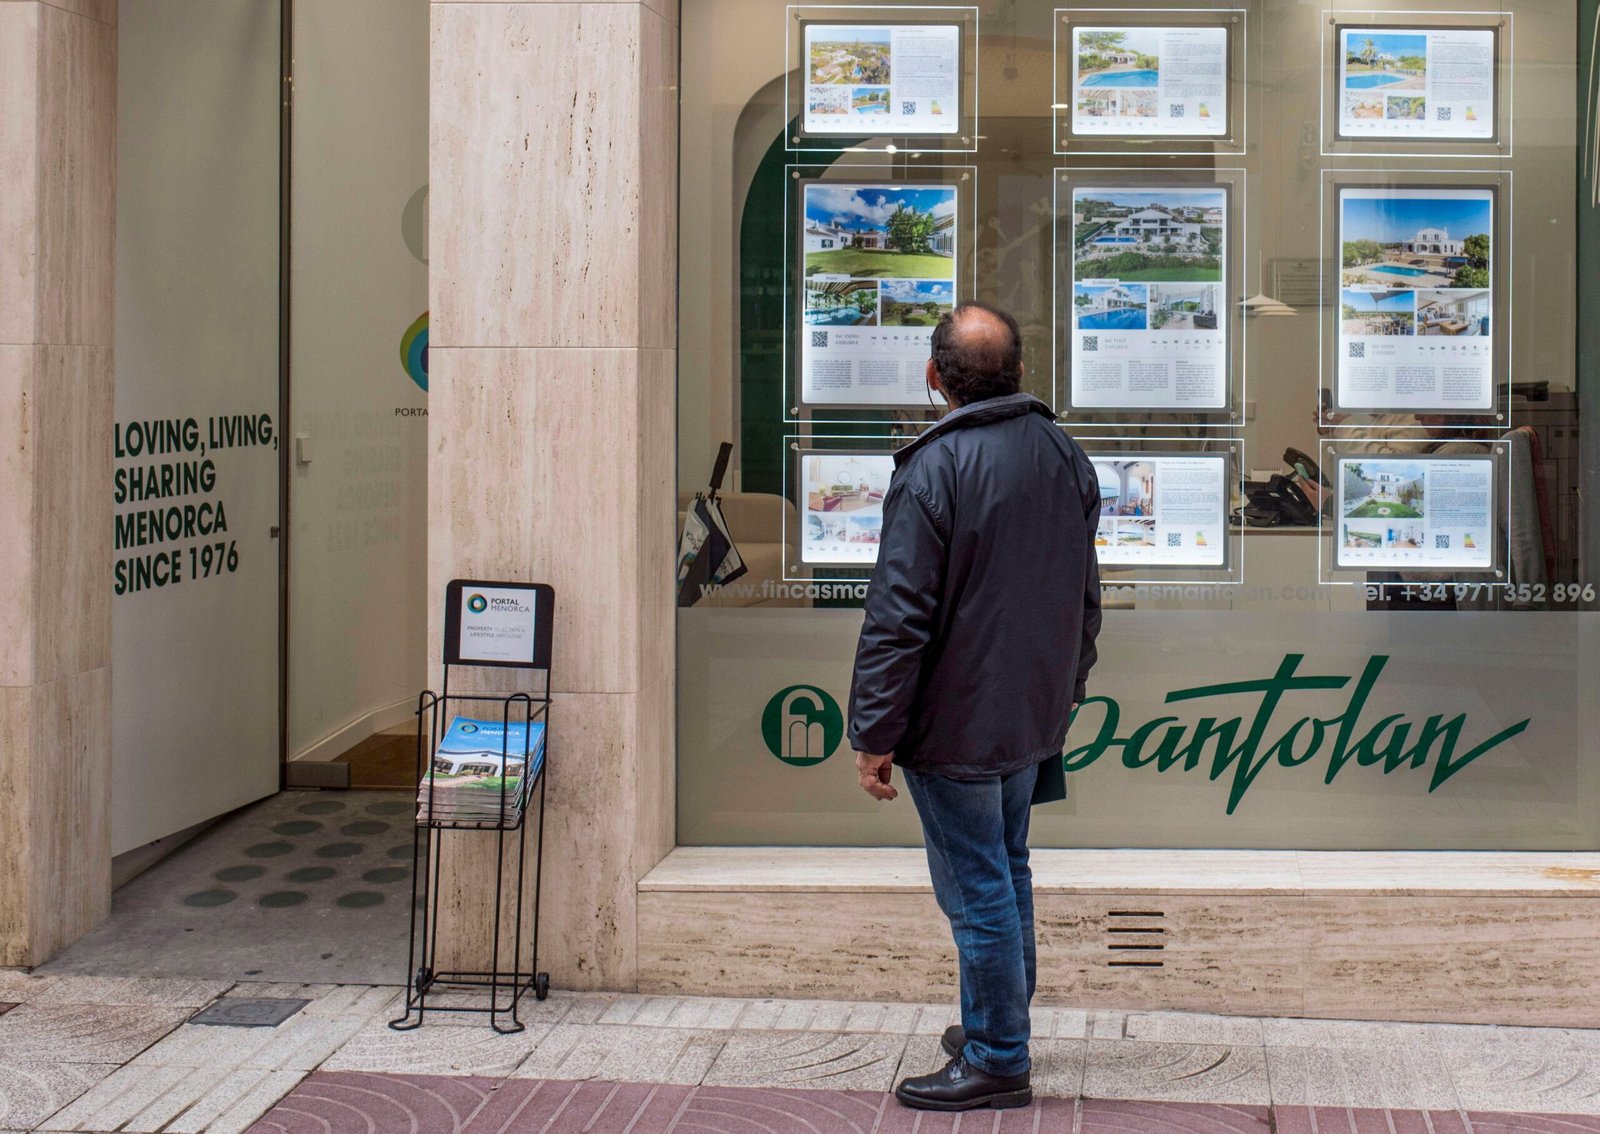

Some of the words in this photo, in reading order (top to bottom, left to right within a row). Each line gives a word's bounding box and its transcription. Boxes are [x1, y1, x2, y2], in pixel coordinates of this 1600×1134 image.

[115, 417, 205, 458] LOVING,
[209, 413, 278, 451] LIVING,
[114, 459, 216, 504] SHARING
[115, 500, 228, 550] MENORCA
[114, 549, 181, 596] SINCE
[189, 540, 239, 580] 1976
[1353, 582, 1391, 602] Tel.
[1401, 583, 1448, 602] +34
[1453, 583, 1494, 603] 971
[1503, 583, 1546, 603] 352
[1552, 583, 1596, 604] 896
